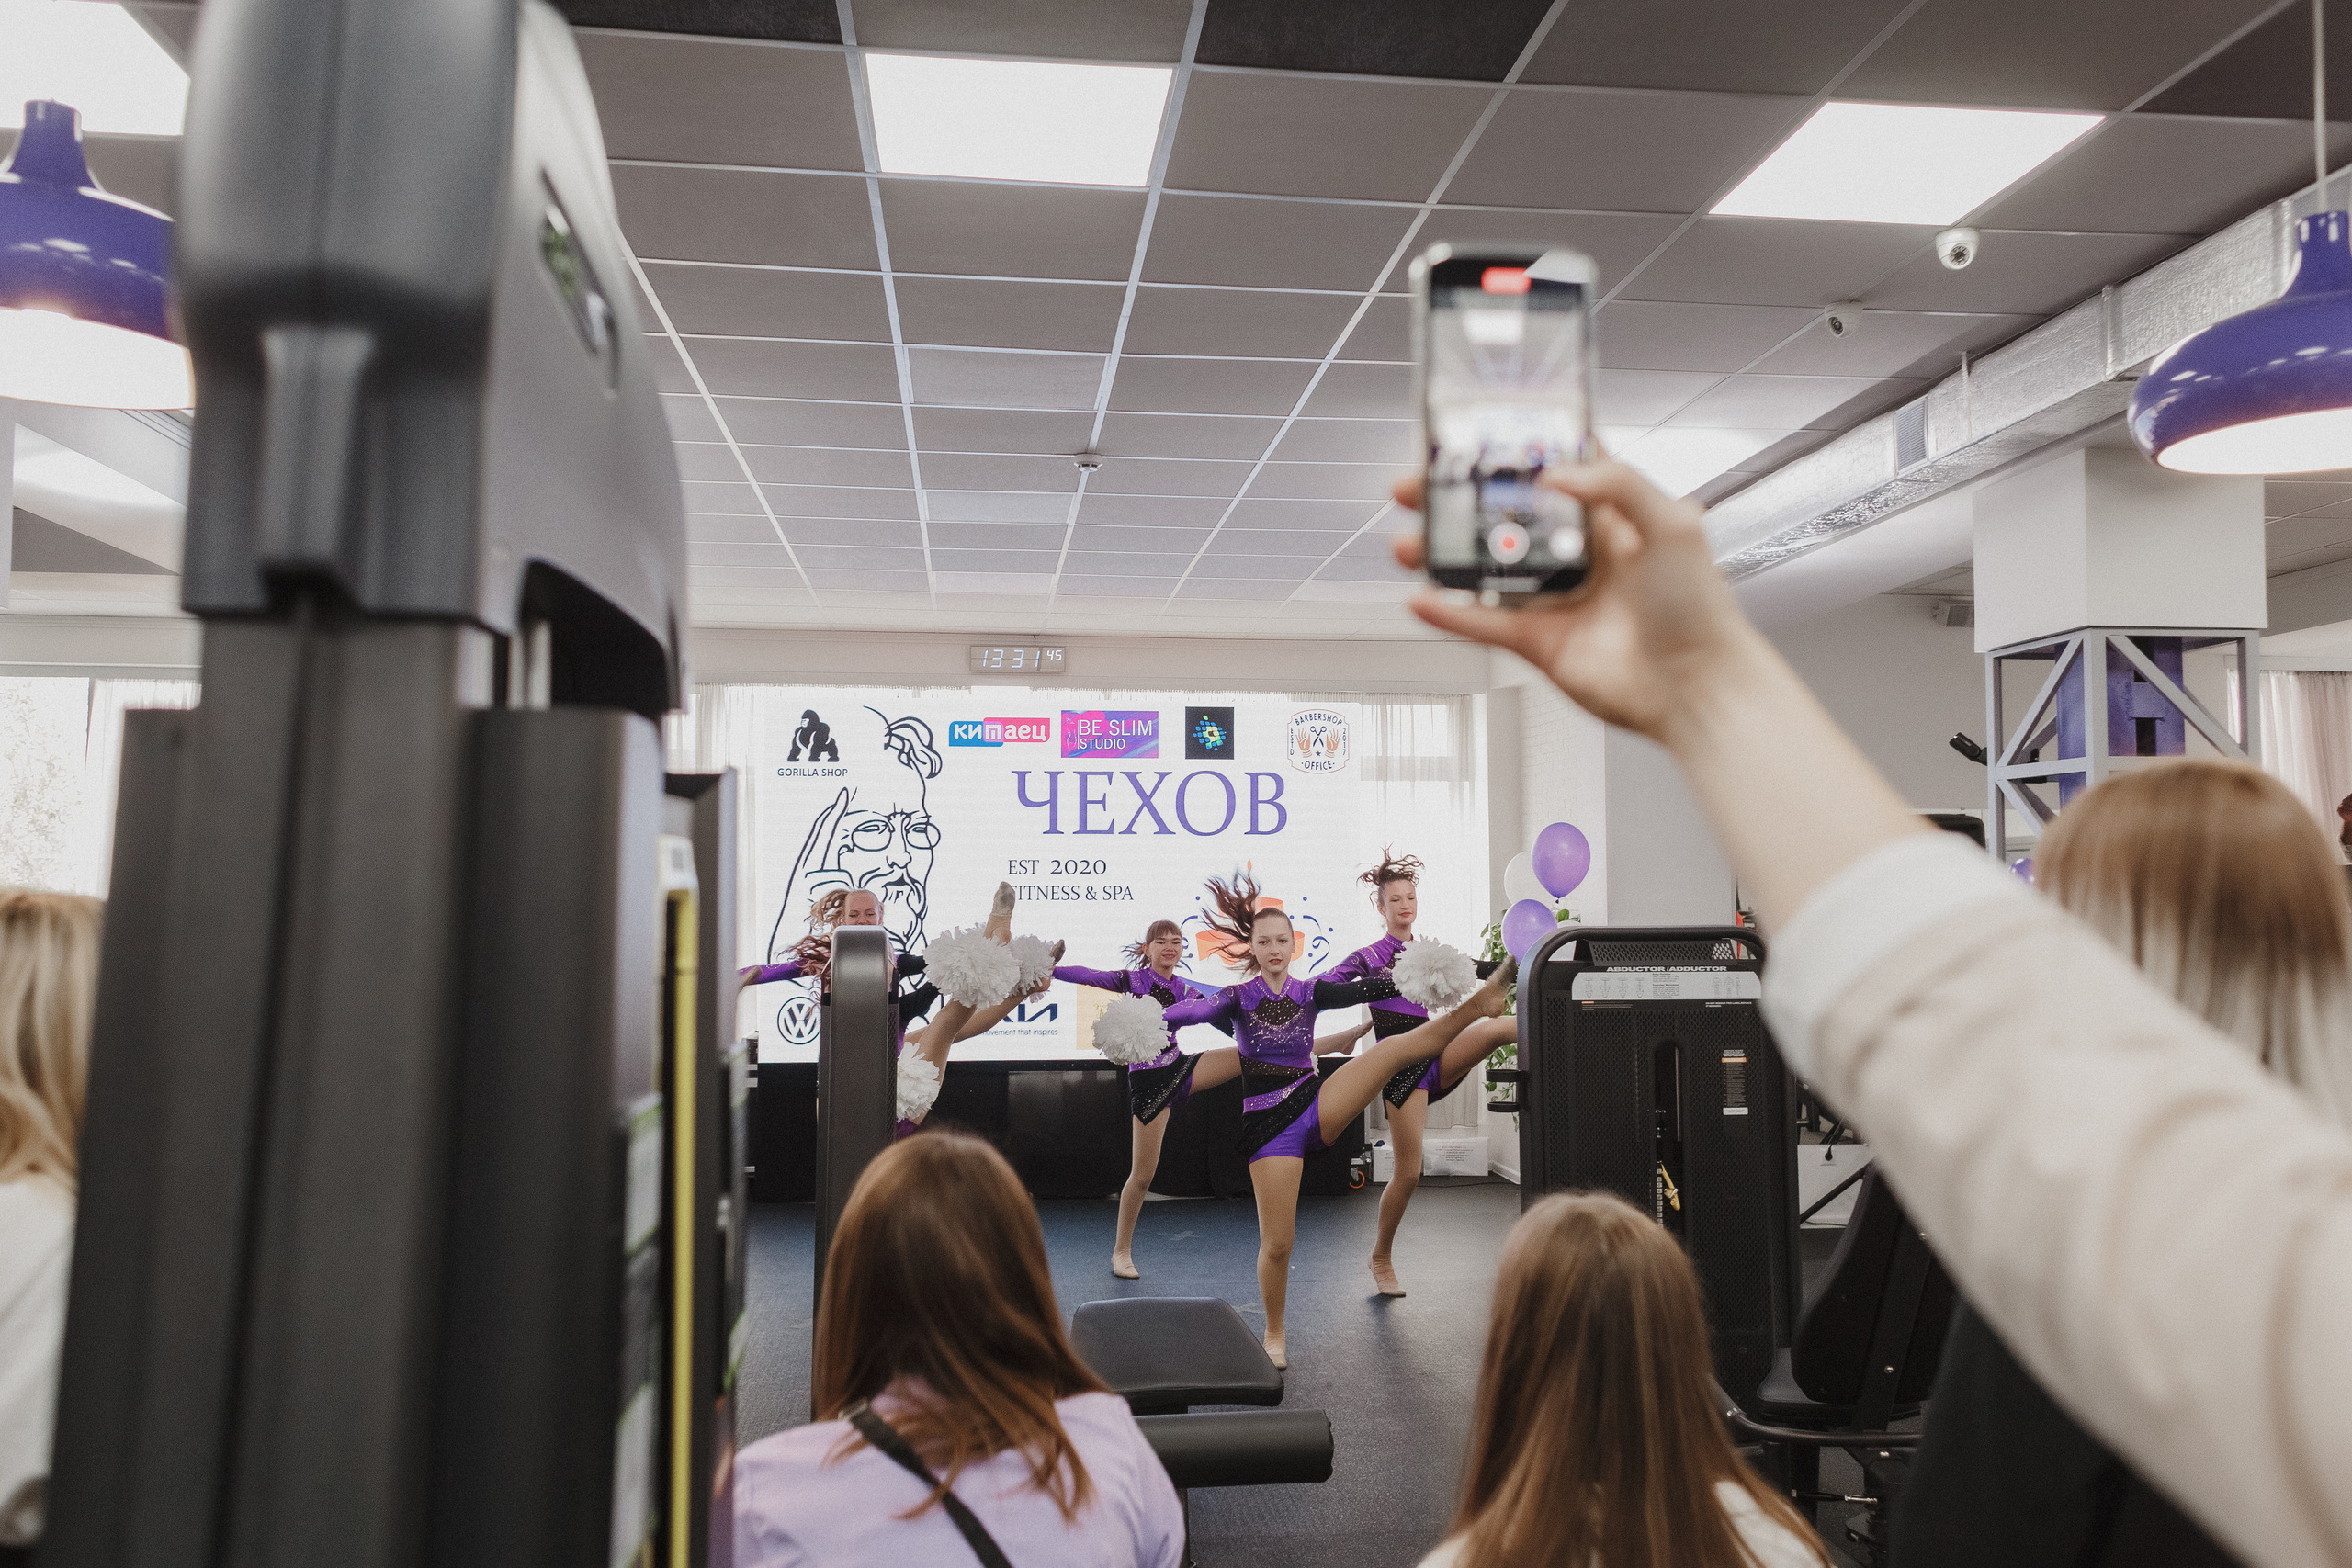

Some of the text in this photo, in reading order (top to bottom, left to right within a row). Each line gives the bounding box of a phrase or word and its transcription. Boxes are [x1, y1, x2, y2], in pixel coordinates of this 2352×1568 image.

[1046, 649, 1063, 661] 45
[1294, 712, 1343, 726] BARBERSHOP
[1079, 719, 1153, 736] BE SLIM
[1079, 738, 1126, 750] STUDIO
[1304, 760, 1333, 771] OFFICE
[777, 768, 848, 777] GORILLA SHOP
[1011, 770, 1288, 836] ЧЕХОВ
[1008, 859, 1107, 875] EST 2020
[1085, 885, 1098, 901] &
[1102, 886, 1134, 901] SPA
[1033, 1029, 1058, 1037] inspires
